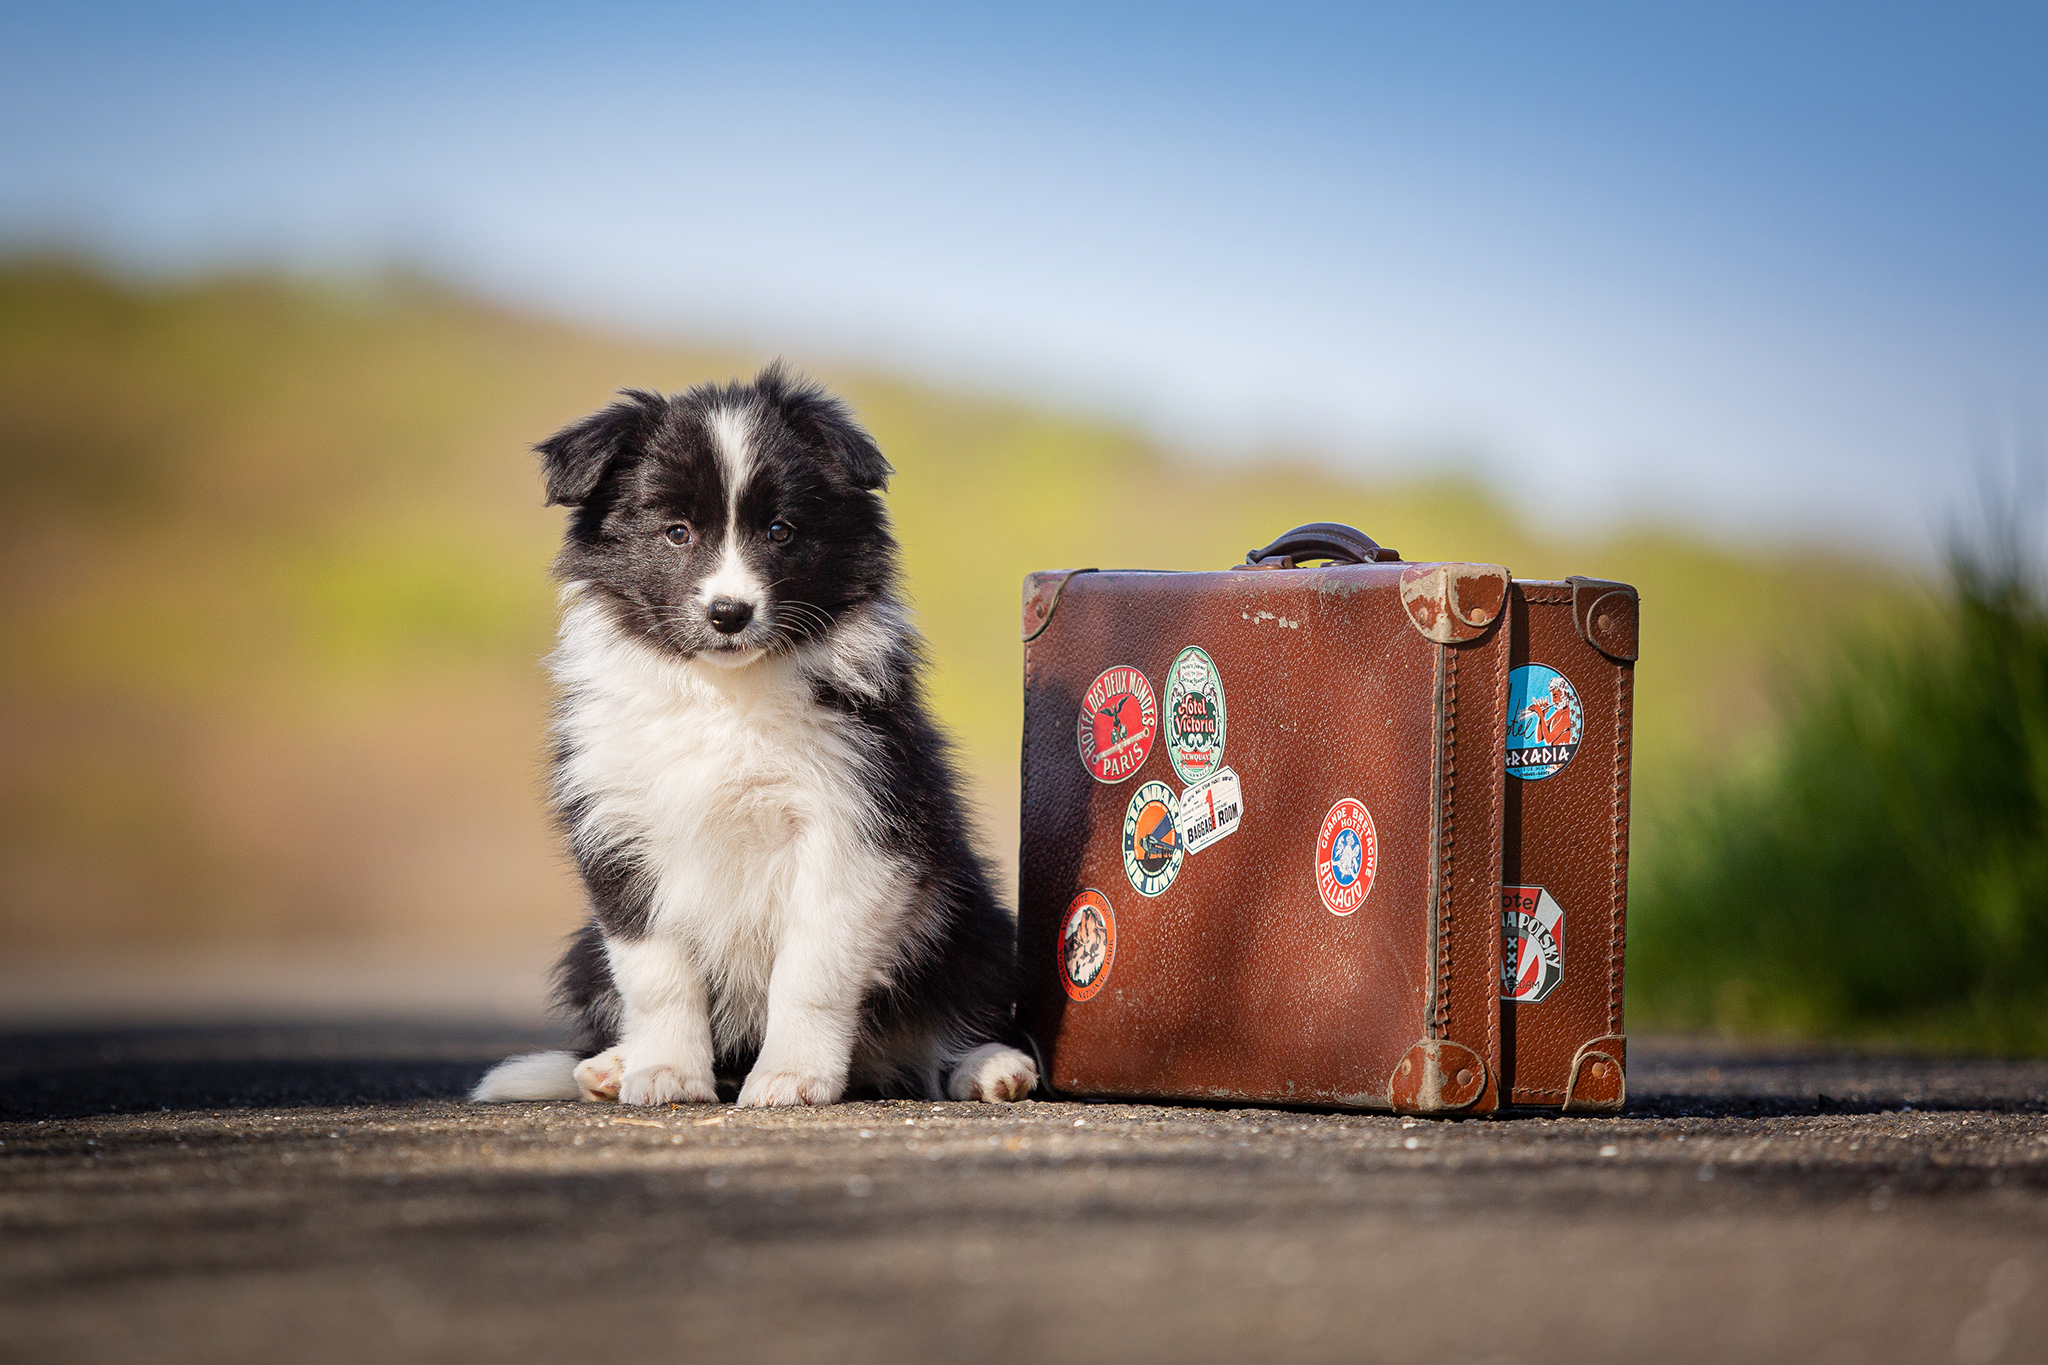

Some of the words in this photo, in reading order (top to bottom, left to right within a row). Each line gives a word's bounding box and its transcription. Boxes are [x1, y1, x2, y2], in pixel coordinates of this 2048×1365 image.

[1088, 682, 1106, 713] DES
[1104, 670, 1128, 699] DEUX
[1129, 671, 1155, 727] MONDES
[1175, 714, 1216, 737] Victoria
[1103, 743, 1144, 777] PARIS
[1181, 753, 1210, 763] NEWQUAY
[1126, 785, 1182, 835] STANDARD
[1187, 817, 1217, 844] BAGGAGE
[1218, 802, 1239, 827] ROOM
[1206, 789, 1217, 831] 1
[1322, 807, 1347, 849] GRANDE
[1352, 808, 1373, 878] BRETAGNE
[1126, 851, 1145, 888] AIR
[1145, 849, 1182, 893] LINES
[1320, 861, 1362, 908] BELLAGIO
[1078, 974, 1106, 999] NATIONAL
